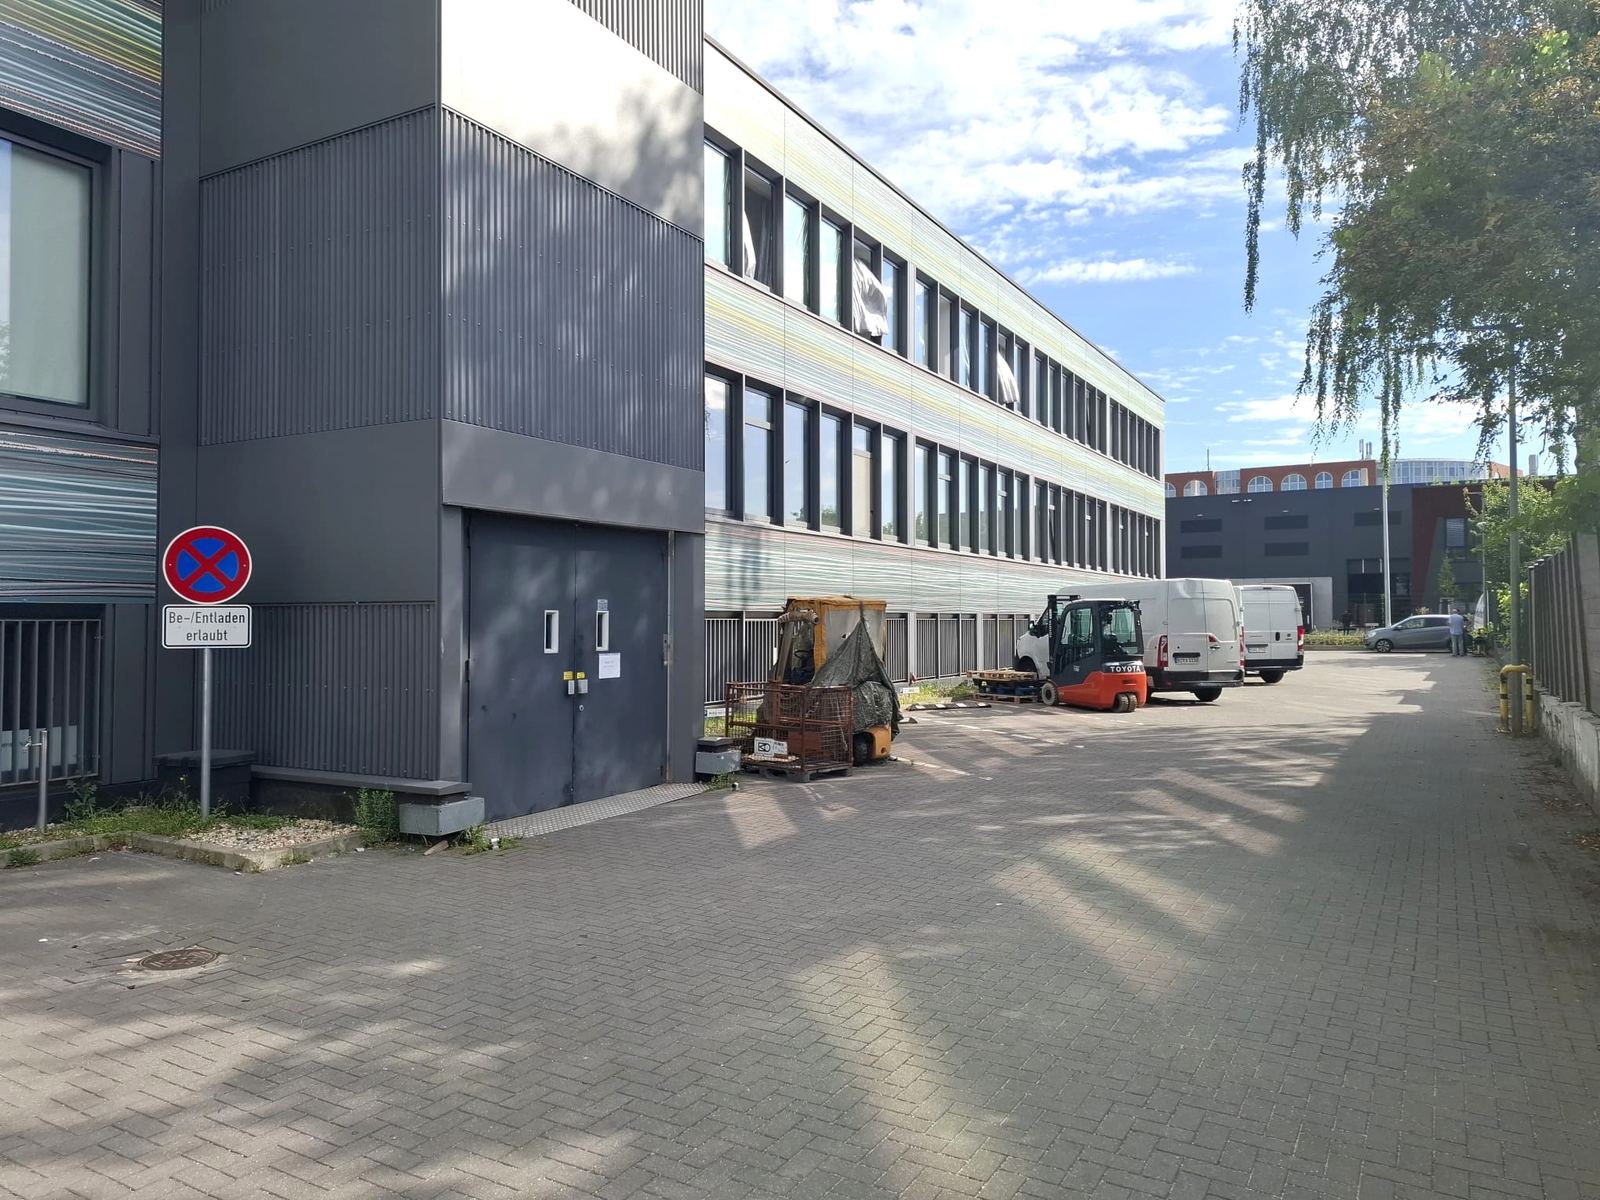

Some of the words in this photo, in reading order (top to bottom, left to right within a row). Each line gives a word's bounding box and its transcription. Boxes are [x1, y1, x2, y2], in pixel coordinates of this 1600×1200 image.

[169, 611, 245, 624] Be-/Entladen
[186, 630, 228, 641] erlaubt
[1110, 665, 1141, 673] TOYOTA
